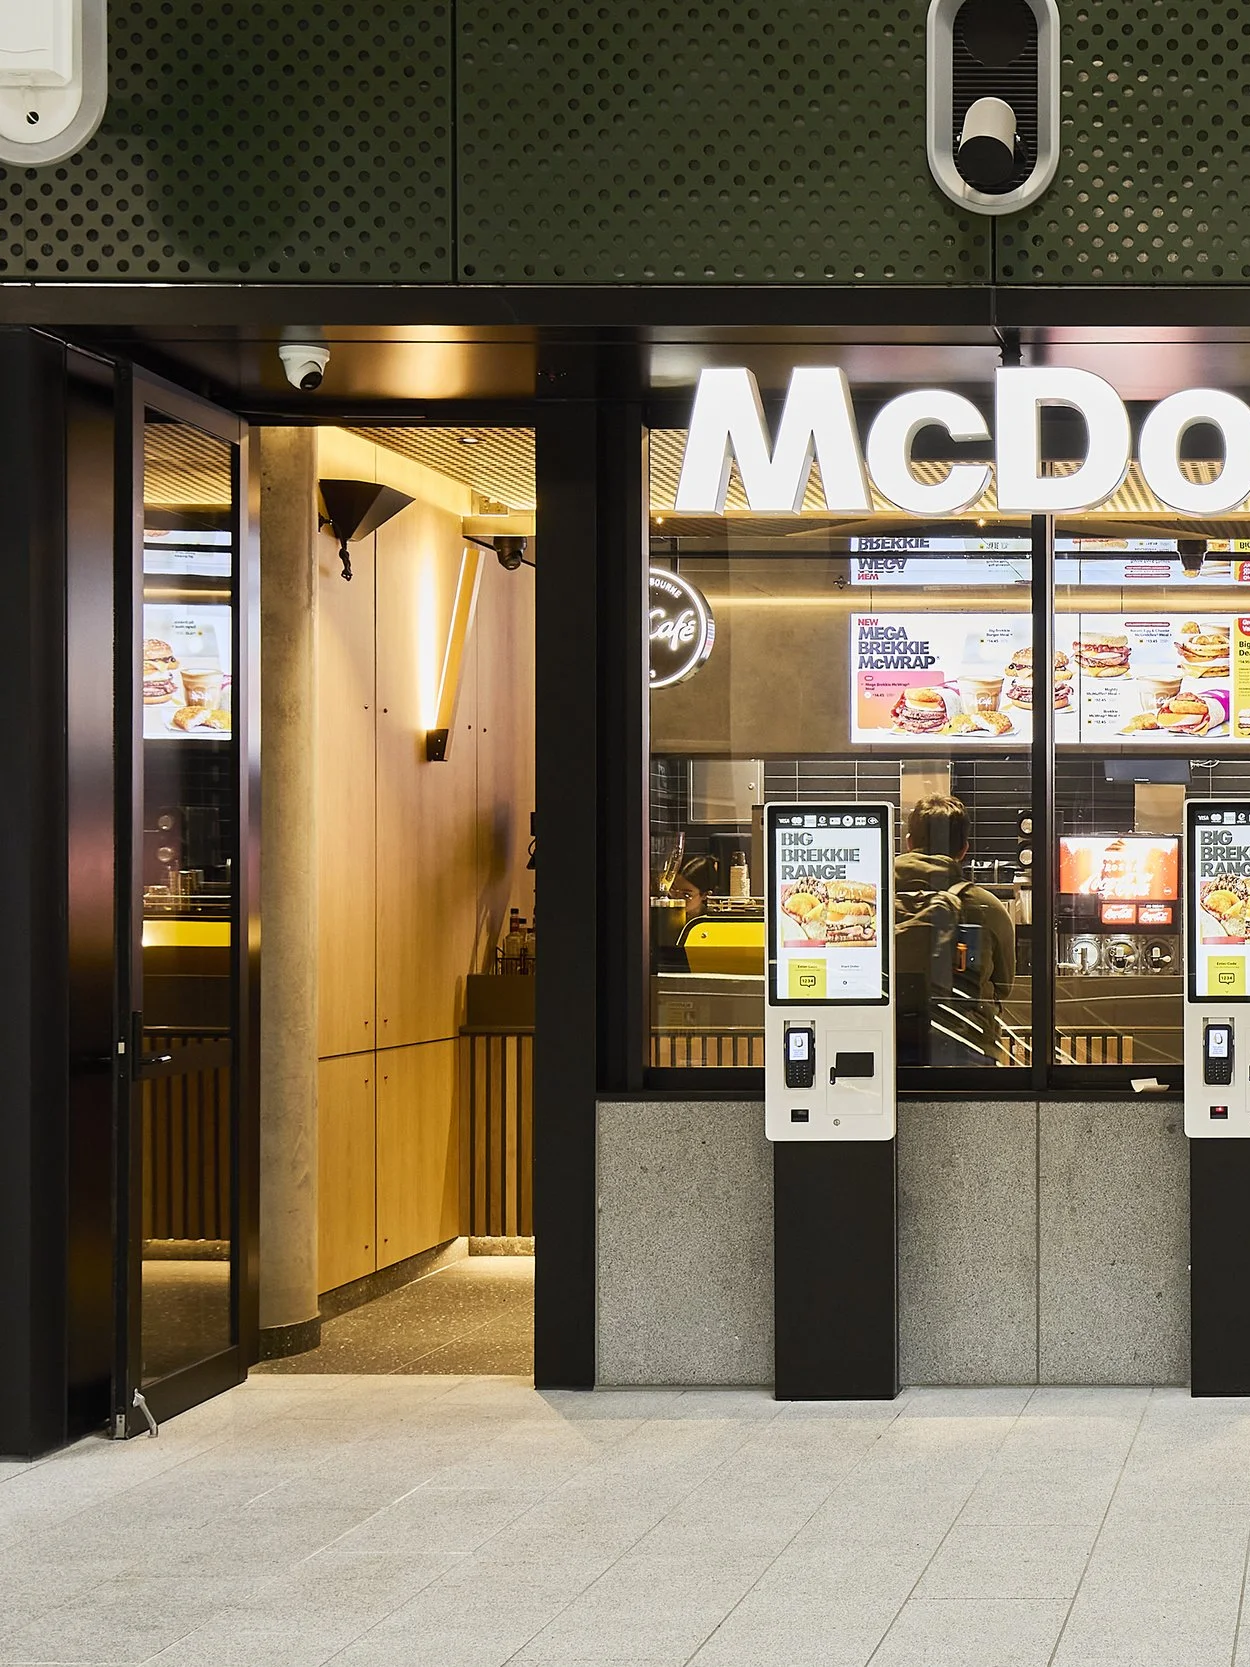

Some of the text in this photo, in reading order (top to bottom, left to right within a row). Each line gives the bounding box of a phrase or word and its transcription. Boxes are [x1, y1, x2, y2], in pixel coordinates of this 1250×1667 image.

[650, 577, 682, 599] BOURNE
[649, 608, 696, 651] Café
[858, 626, 908, 640] MEGA
[858, 641, 929, 655] BREKKIE
[781, 832, 813, 846] BIG
[1200, 830, 1233, 846] BIG
[781, 848, 860, 862] BREKKIE
[781, 864, 847, 880] RANGE
